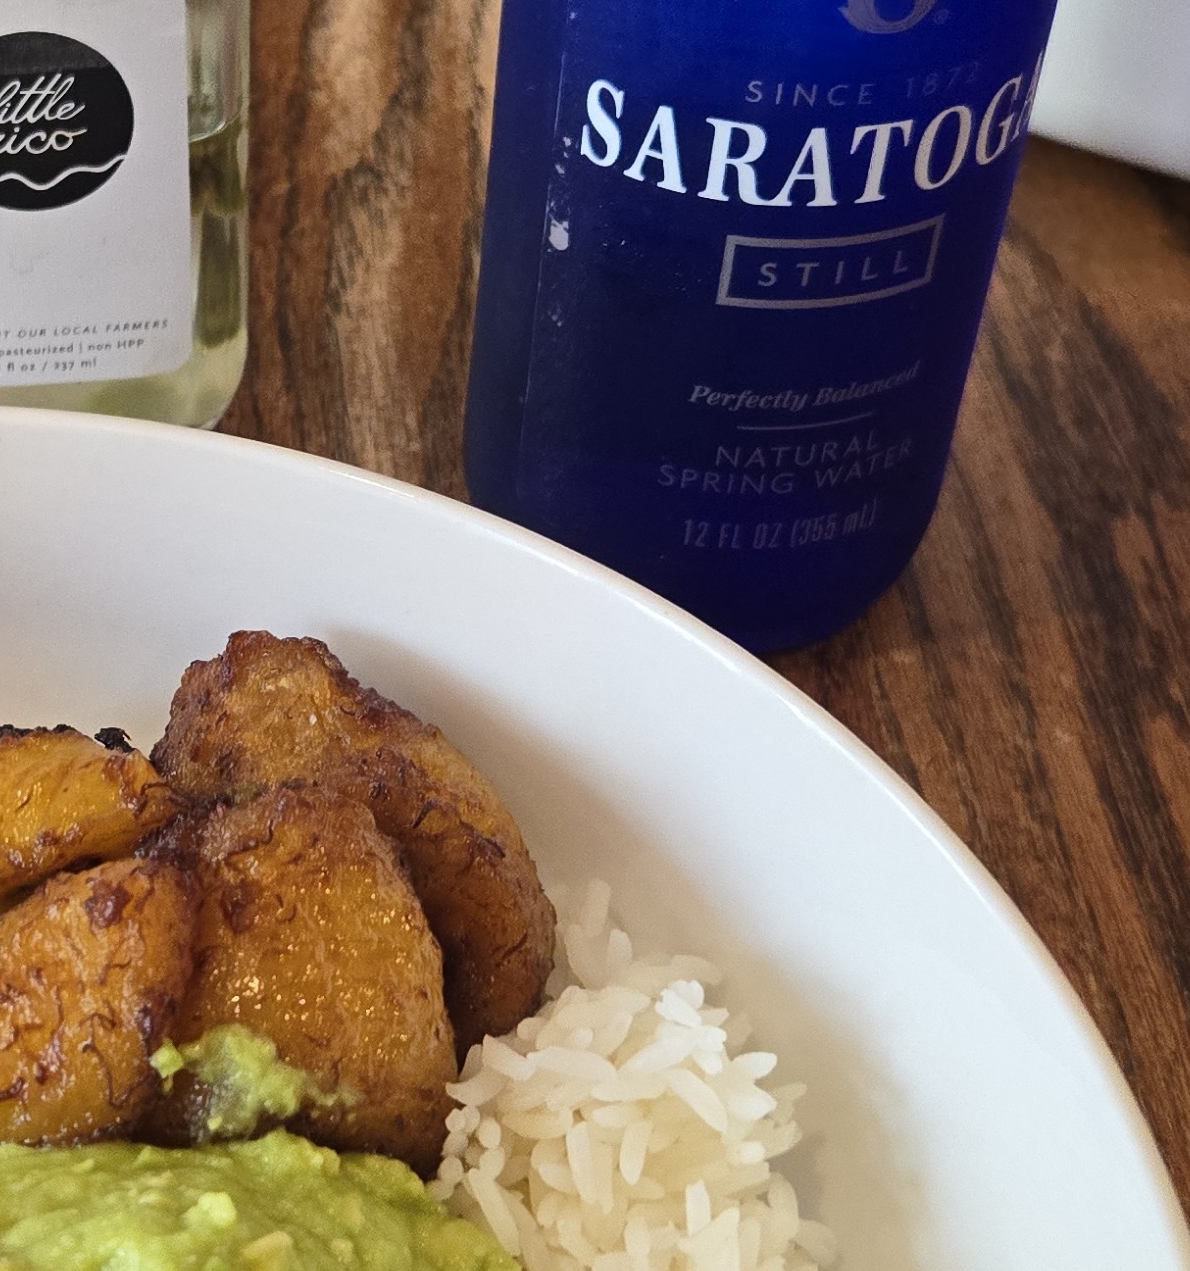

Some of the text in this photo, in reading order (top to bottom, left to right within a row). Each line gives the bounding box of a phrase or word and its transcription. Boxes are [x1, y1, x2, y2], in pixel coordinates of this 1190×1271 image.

[744, 79, 874, 108] SINCE
[757, 250, 910, 288] STILL
[17, 329, 47, 339] OUR
[53, 325, 99, 337] LOCAL
[105, 319, 169, 334] FARMERS
[87, 343, 112, 352] non
[116, 339, 146, 350] HPP
[20, 363, 36, 372] oz
[54, 360, 75, 372] 237
[80, 356, 97, 369] ml
[688, 359, 922, 412] Perfectly Balanced
[656, 438, 912, 495] SPRING WATER
[714, 431, 881, 468] NATURAL
[683, 518, 710, 548] 12
[718, 523, 741, 549] FL
[752, 522, 783, 549] OZ
[789, 511, 839, 548] (355
